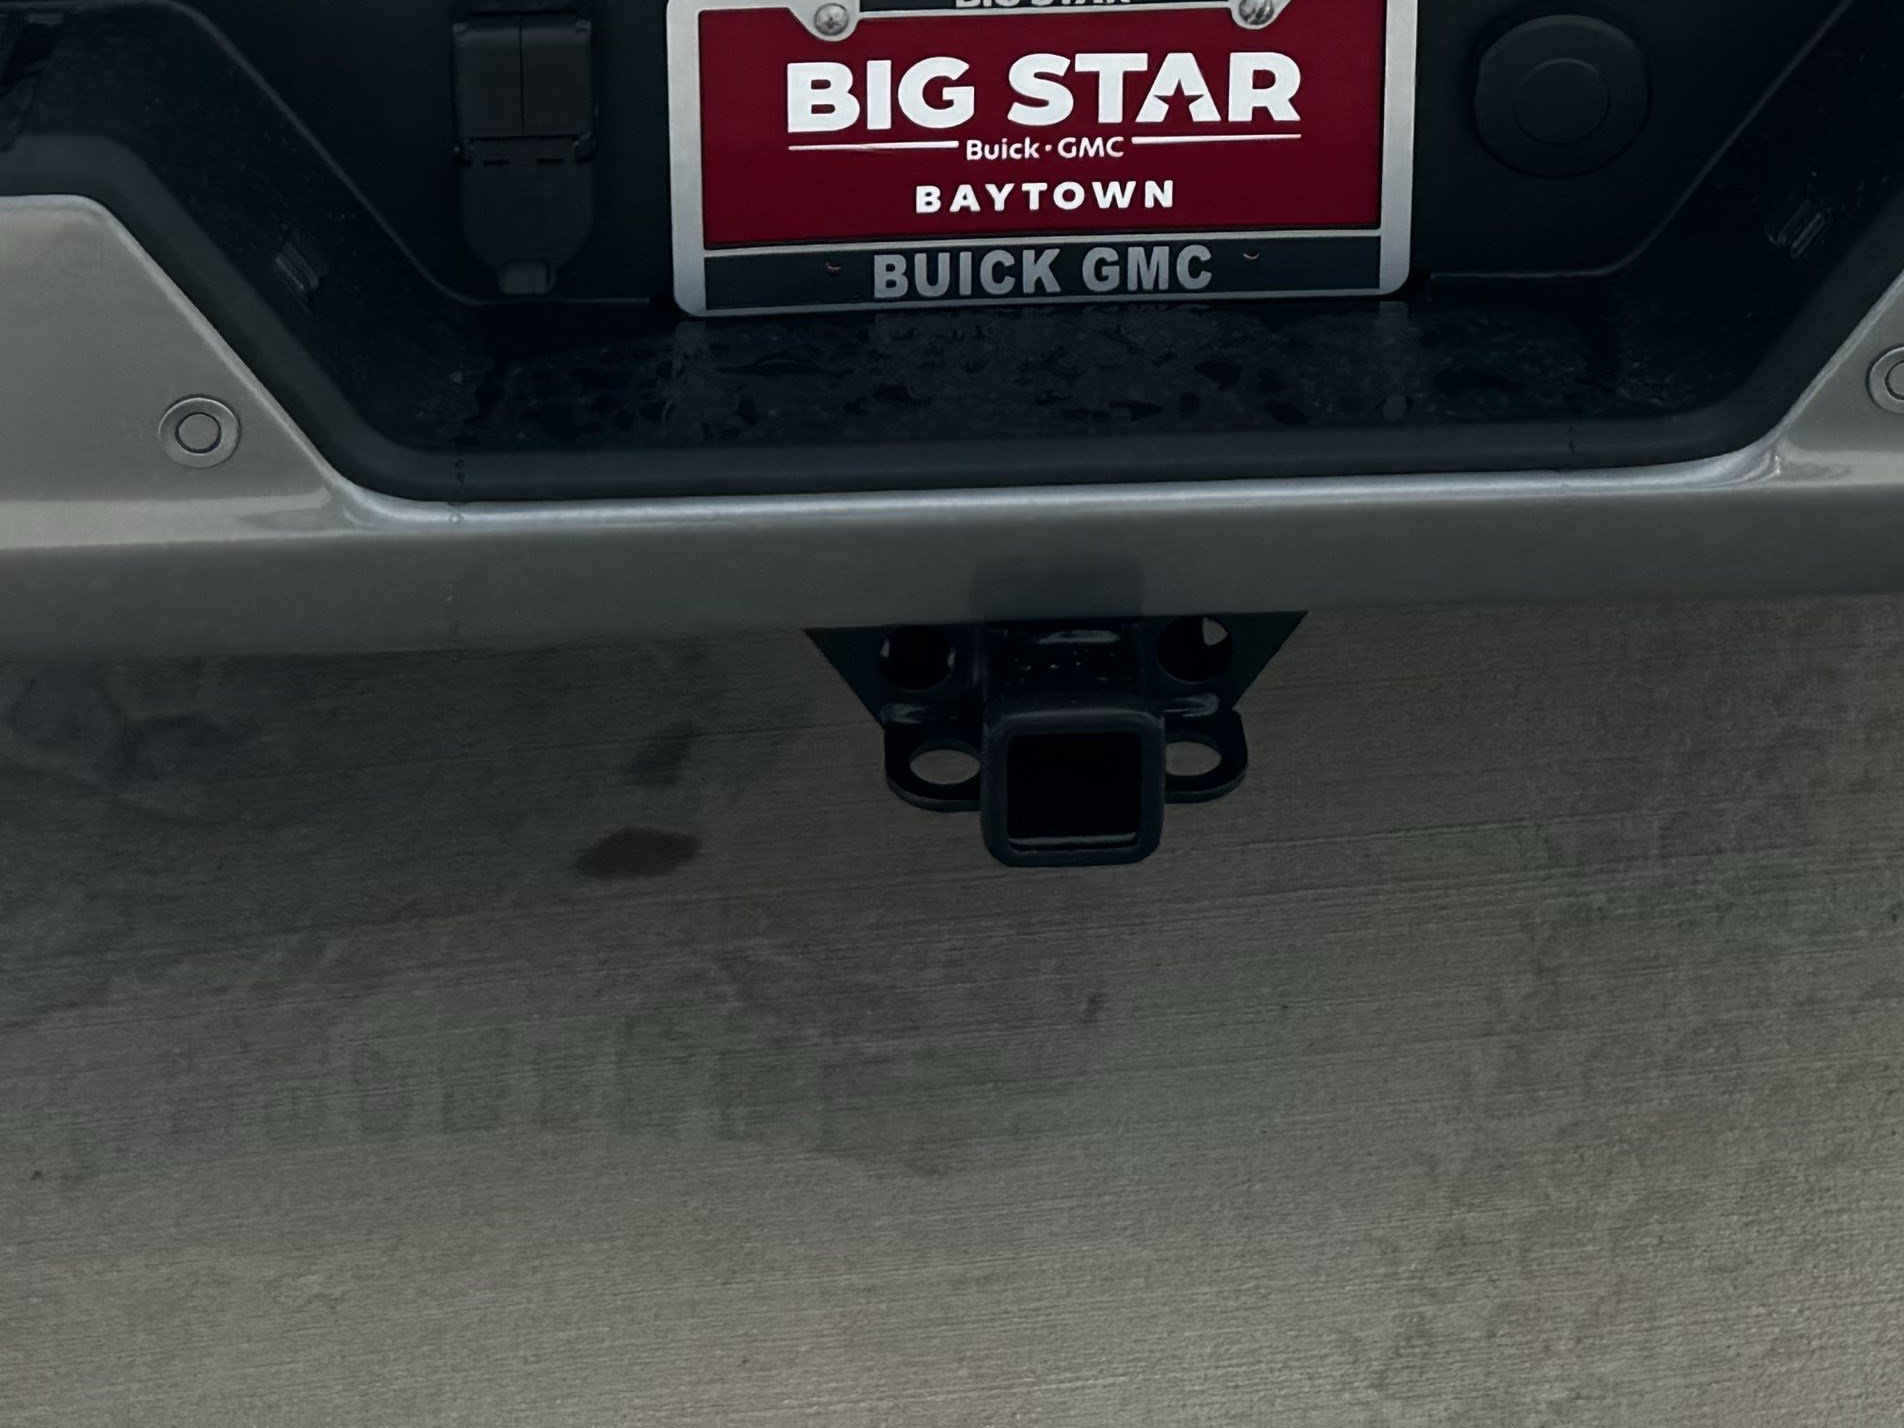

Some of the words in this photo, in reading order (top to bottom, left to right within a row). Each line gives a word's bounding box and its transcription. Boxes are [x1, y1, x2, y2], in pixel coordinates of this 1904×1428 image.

[786, 56, 976, 134] BIG
[1007, 51, 1302, 127] STAR
[965, 136, 1041, 161] Buick
[1057, 136, 1125, 159] GMC
[915, 179, 1175, 214] BAYTOWN
[872, 247, 1063, 299] BUICK
[1081, 244, 1214, 293] GMC
